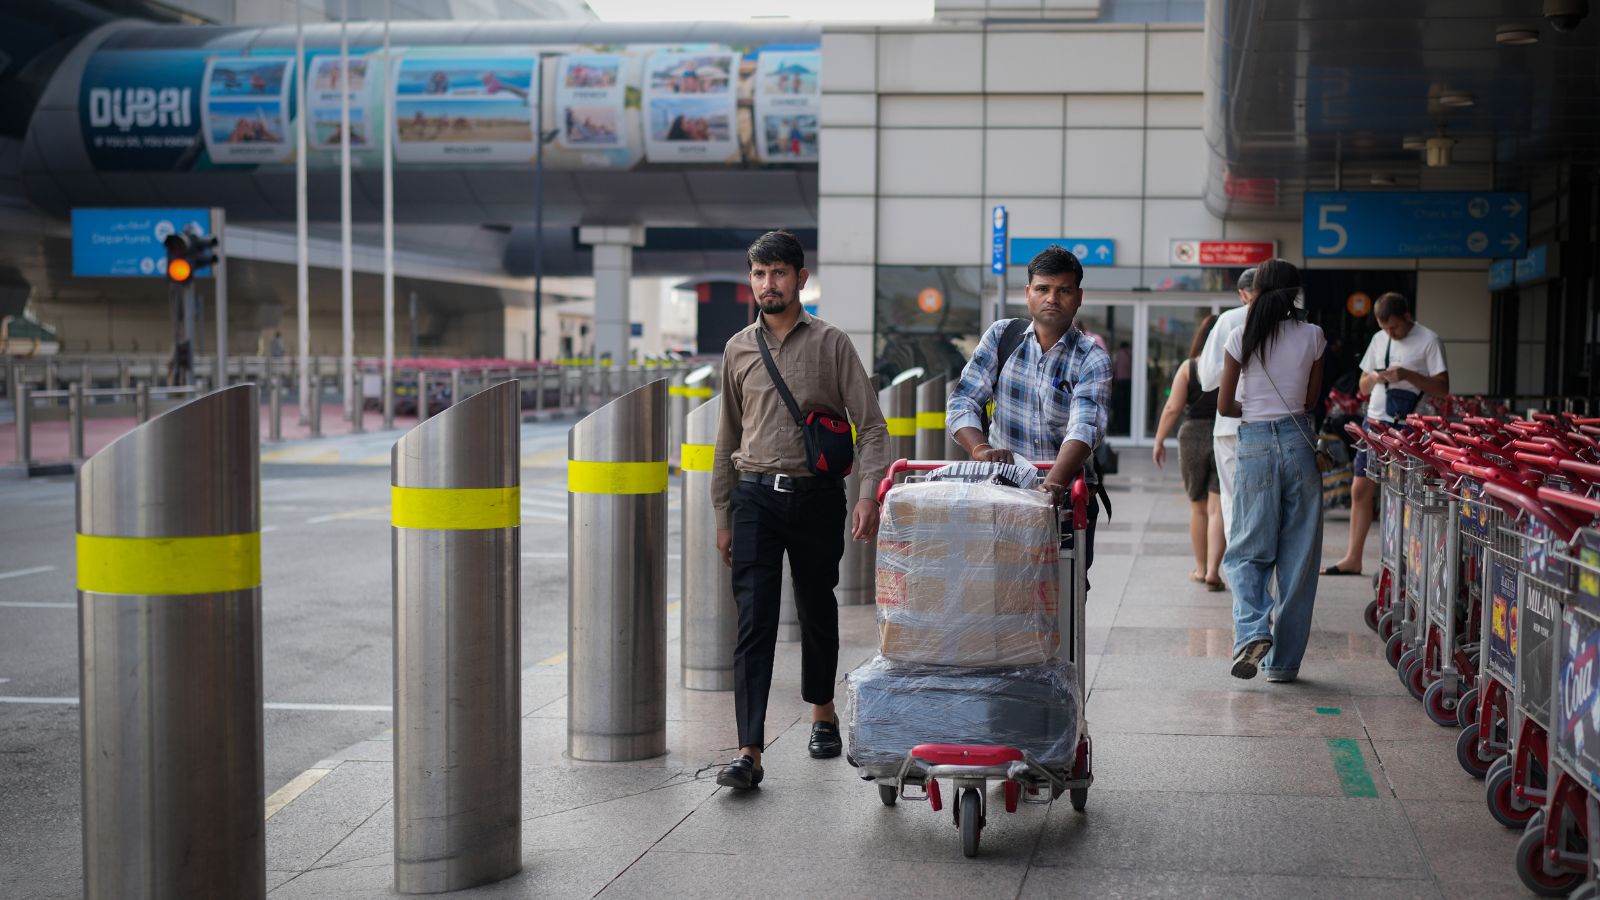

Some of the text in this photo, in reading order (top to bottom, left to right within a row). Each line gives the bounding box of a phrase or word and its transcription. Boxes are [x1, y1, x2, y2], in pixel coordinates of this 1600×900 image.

[90, 88, 192, 131] DUBAI
[91, 232, 151, 246] Departures
[1317, 204, 1348, 255] 5
[1526, 586, 1555, 622] MILAN
